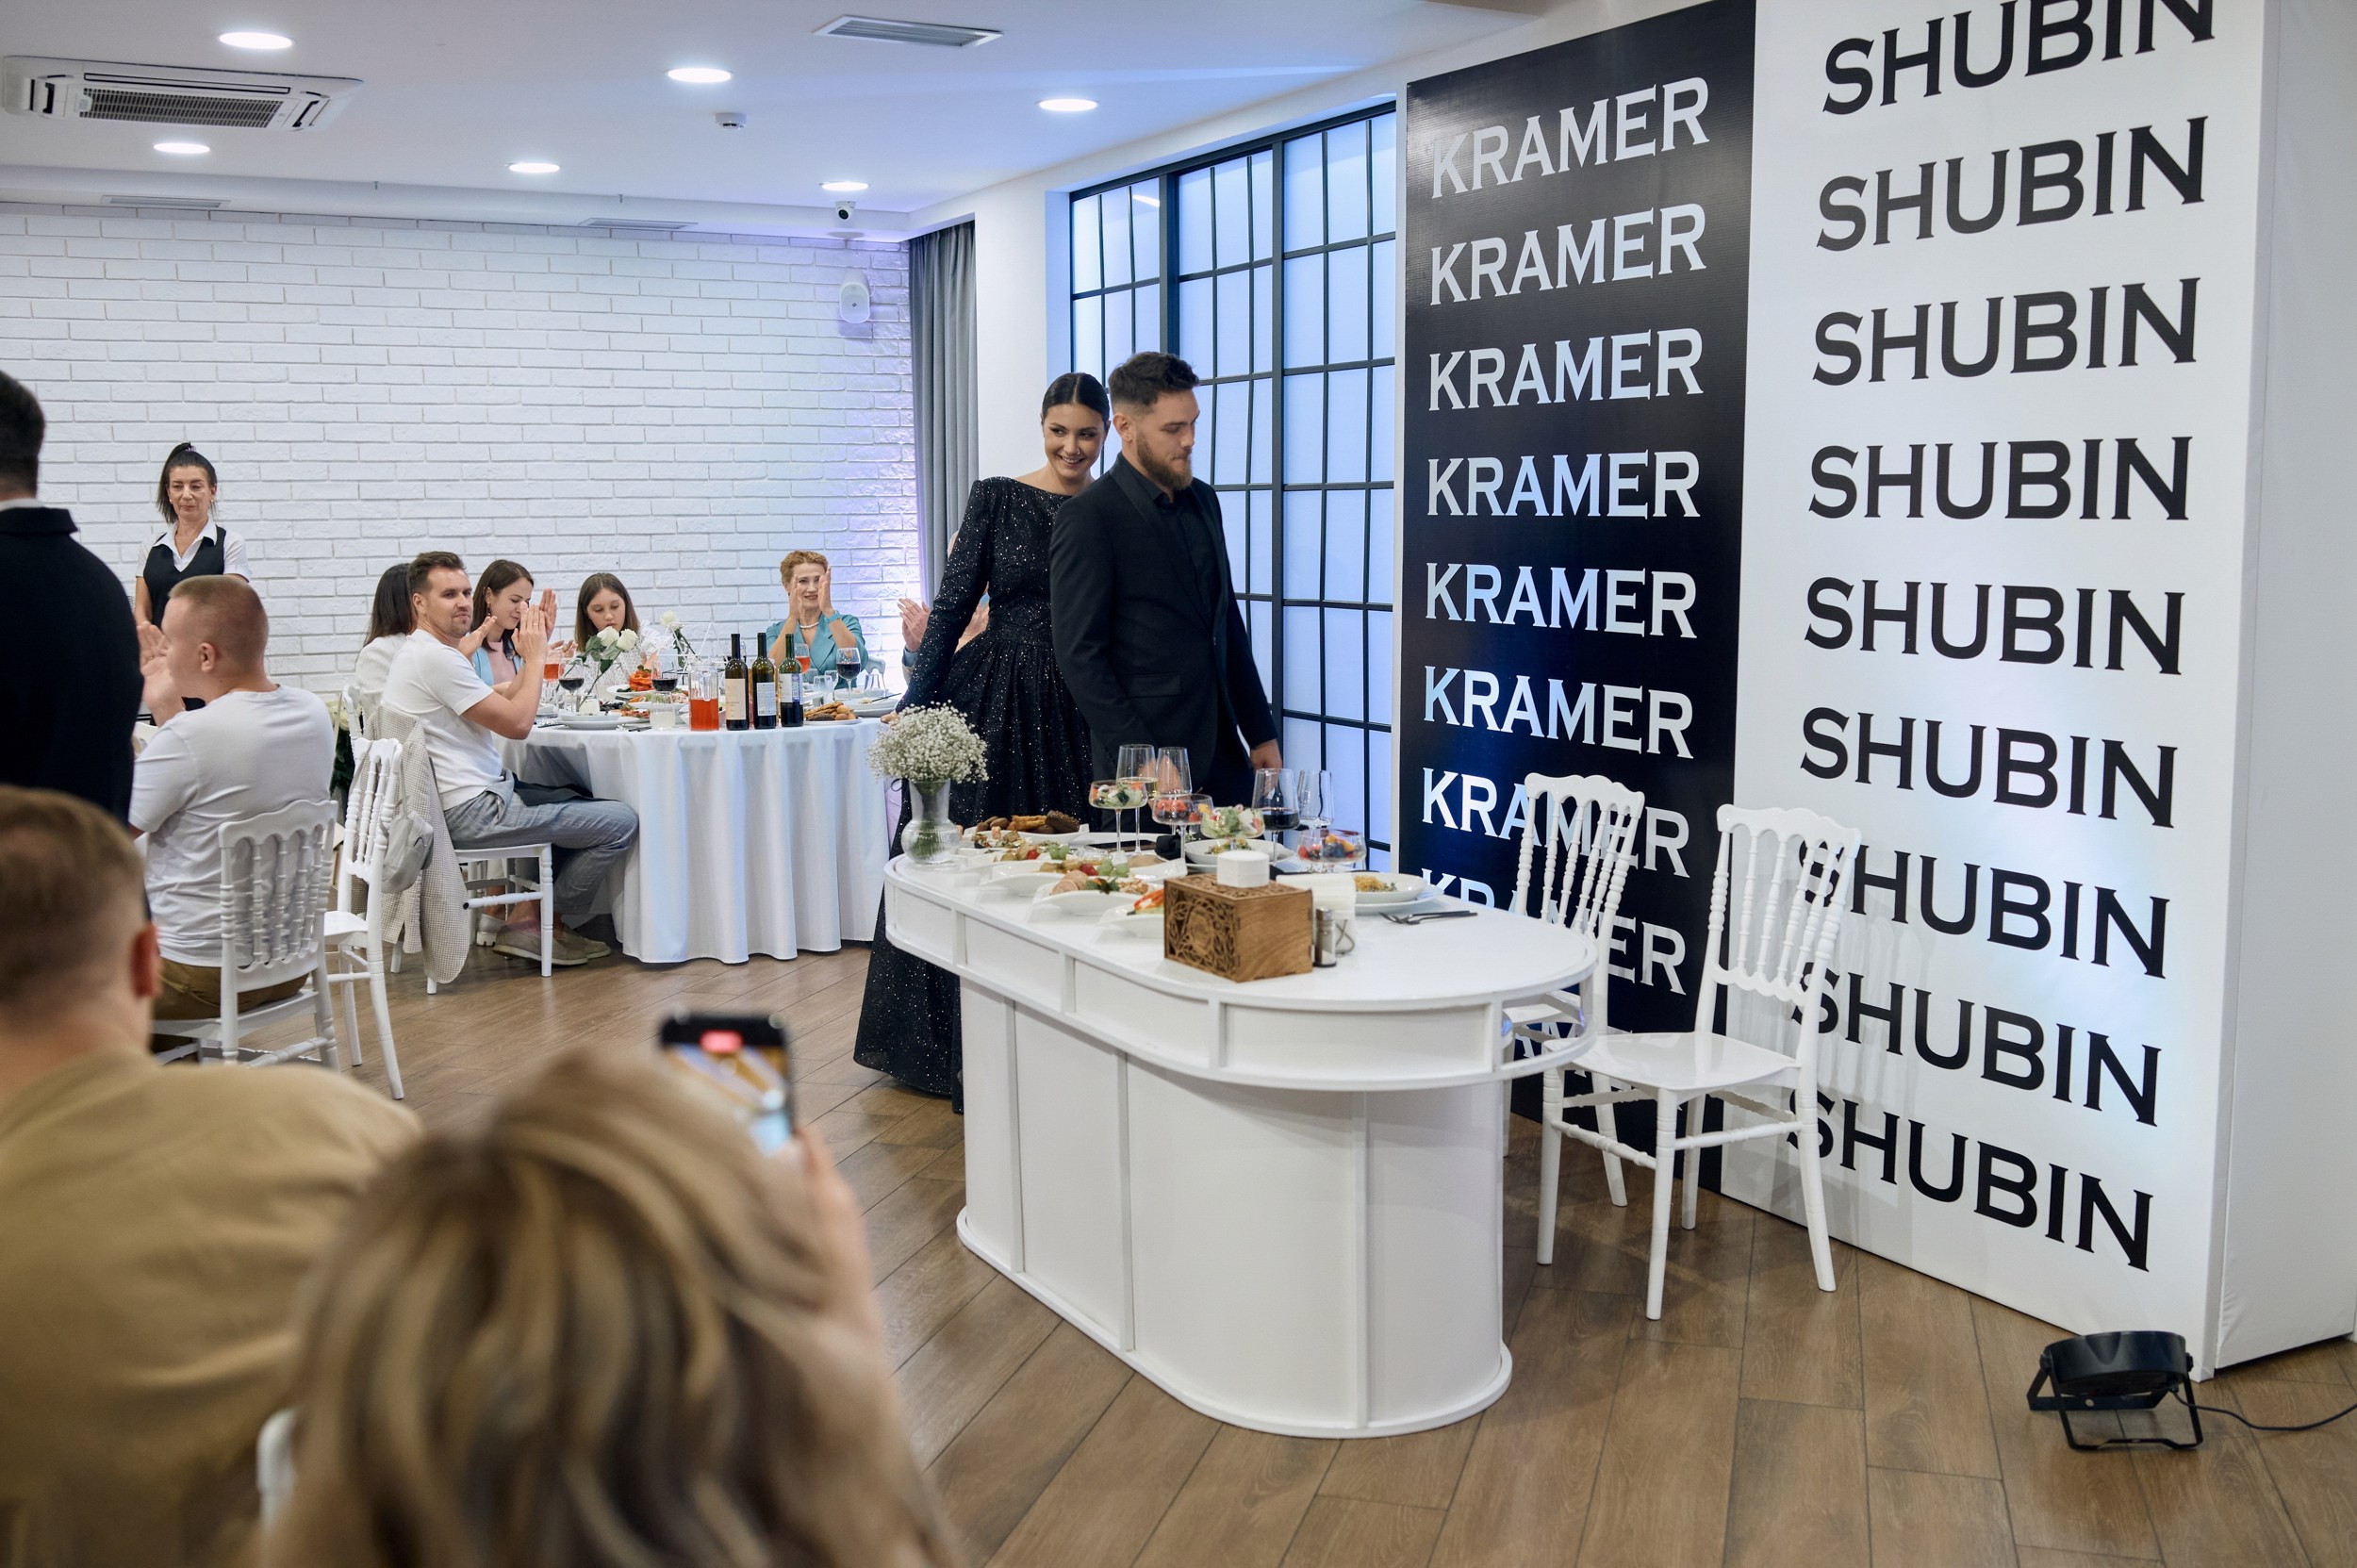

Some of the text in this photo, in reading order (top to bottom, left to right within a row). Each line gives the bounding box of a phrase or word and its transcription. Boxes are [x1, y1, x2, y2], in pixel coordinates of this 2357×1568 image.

[1430, 76, 1709, 199] KRAMER
[1817, 116, 2209, 252] SHUBIN
[1428, 204, 1706, 305] KRAMER
[1427, 328, 1704, 412] KRAMER
[1812, 277, 2200, 387] SHUBIN
[1426, 450, 1701, 520] KRAMER
[1808, 437, 2193, 521] SHUBIN
[1426, 563, 1697, 639] KRAMER
[1804, 576, 2185, 676] SHUBIN
[1424, 666, 1694, 759] KRAMER
[1800, 707, 2178, 829] SHUBIN
